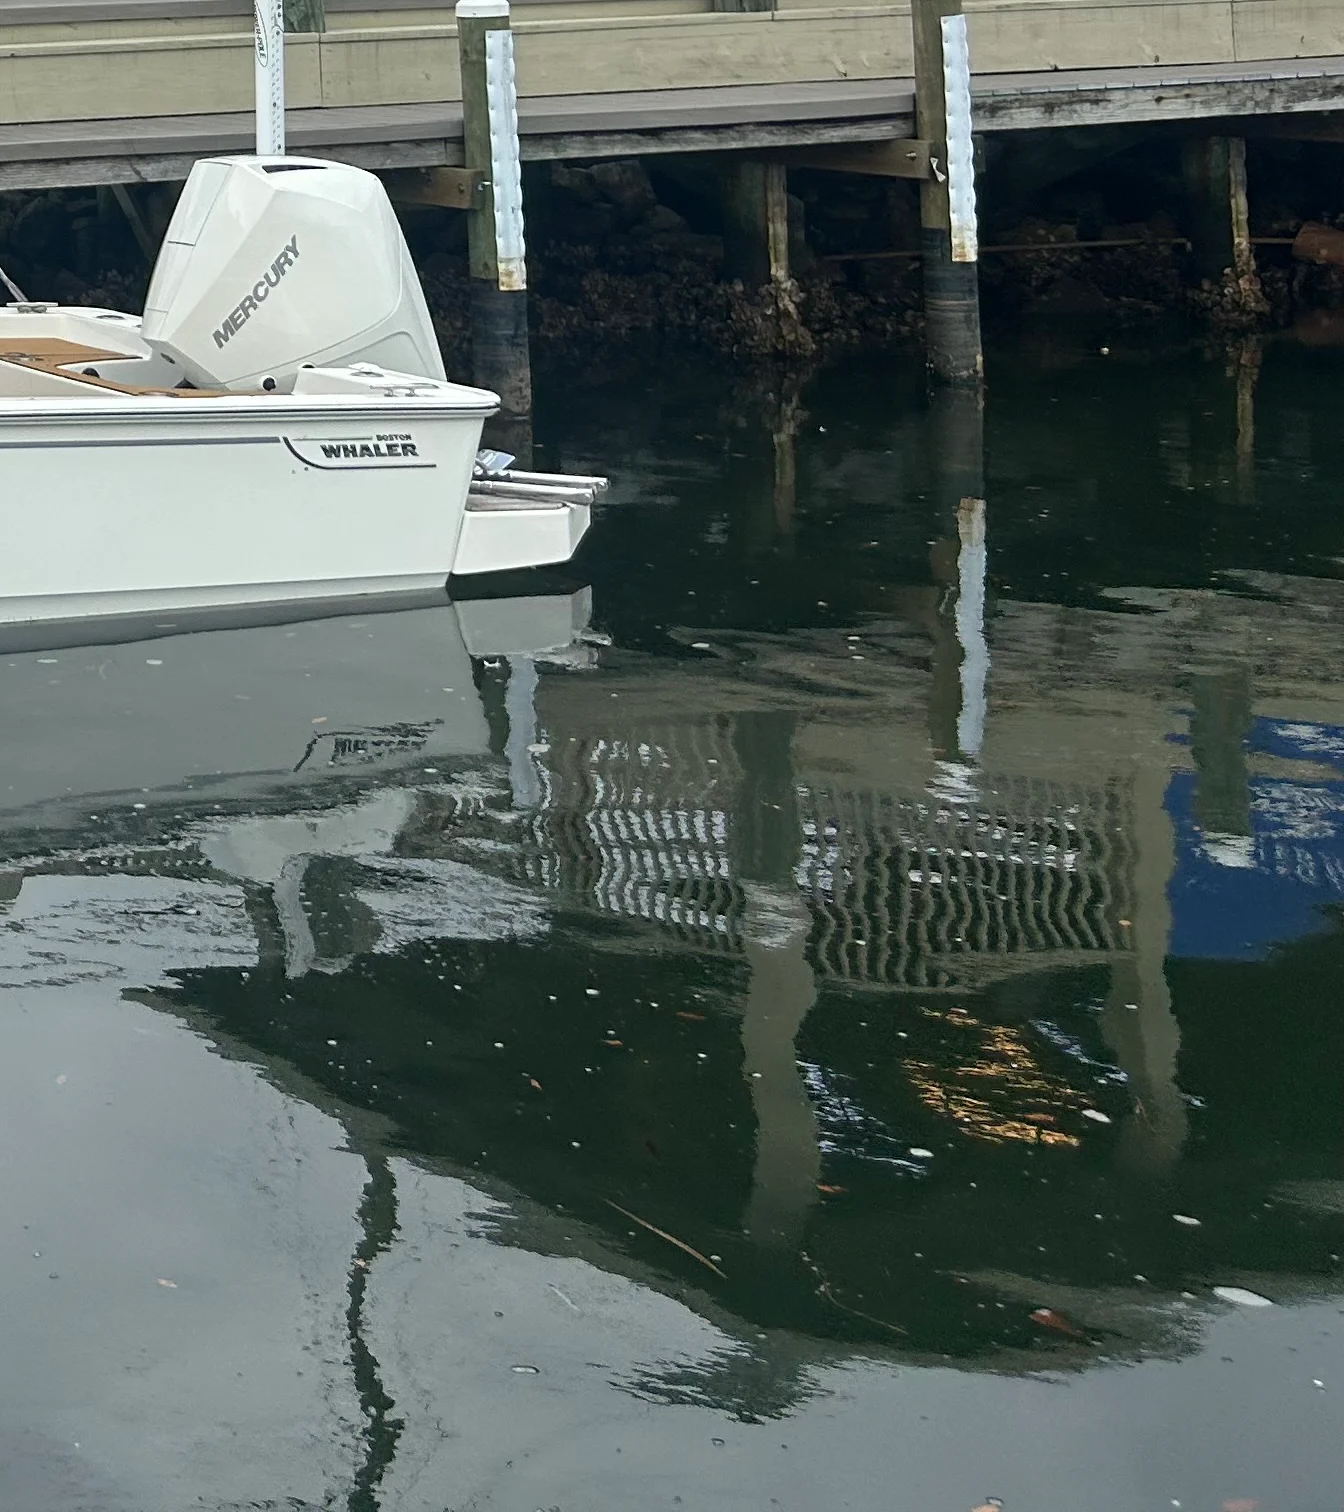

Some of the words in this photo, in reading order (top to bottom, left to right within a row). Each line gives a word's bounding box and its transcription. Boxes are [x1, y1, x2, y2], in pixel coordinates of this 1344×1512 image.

[212, 234, 300, 349] MERCURY
[375, 433, 412, 442] BOSTON
[320, 443, 419, 459] WHALER
